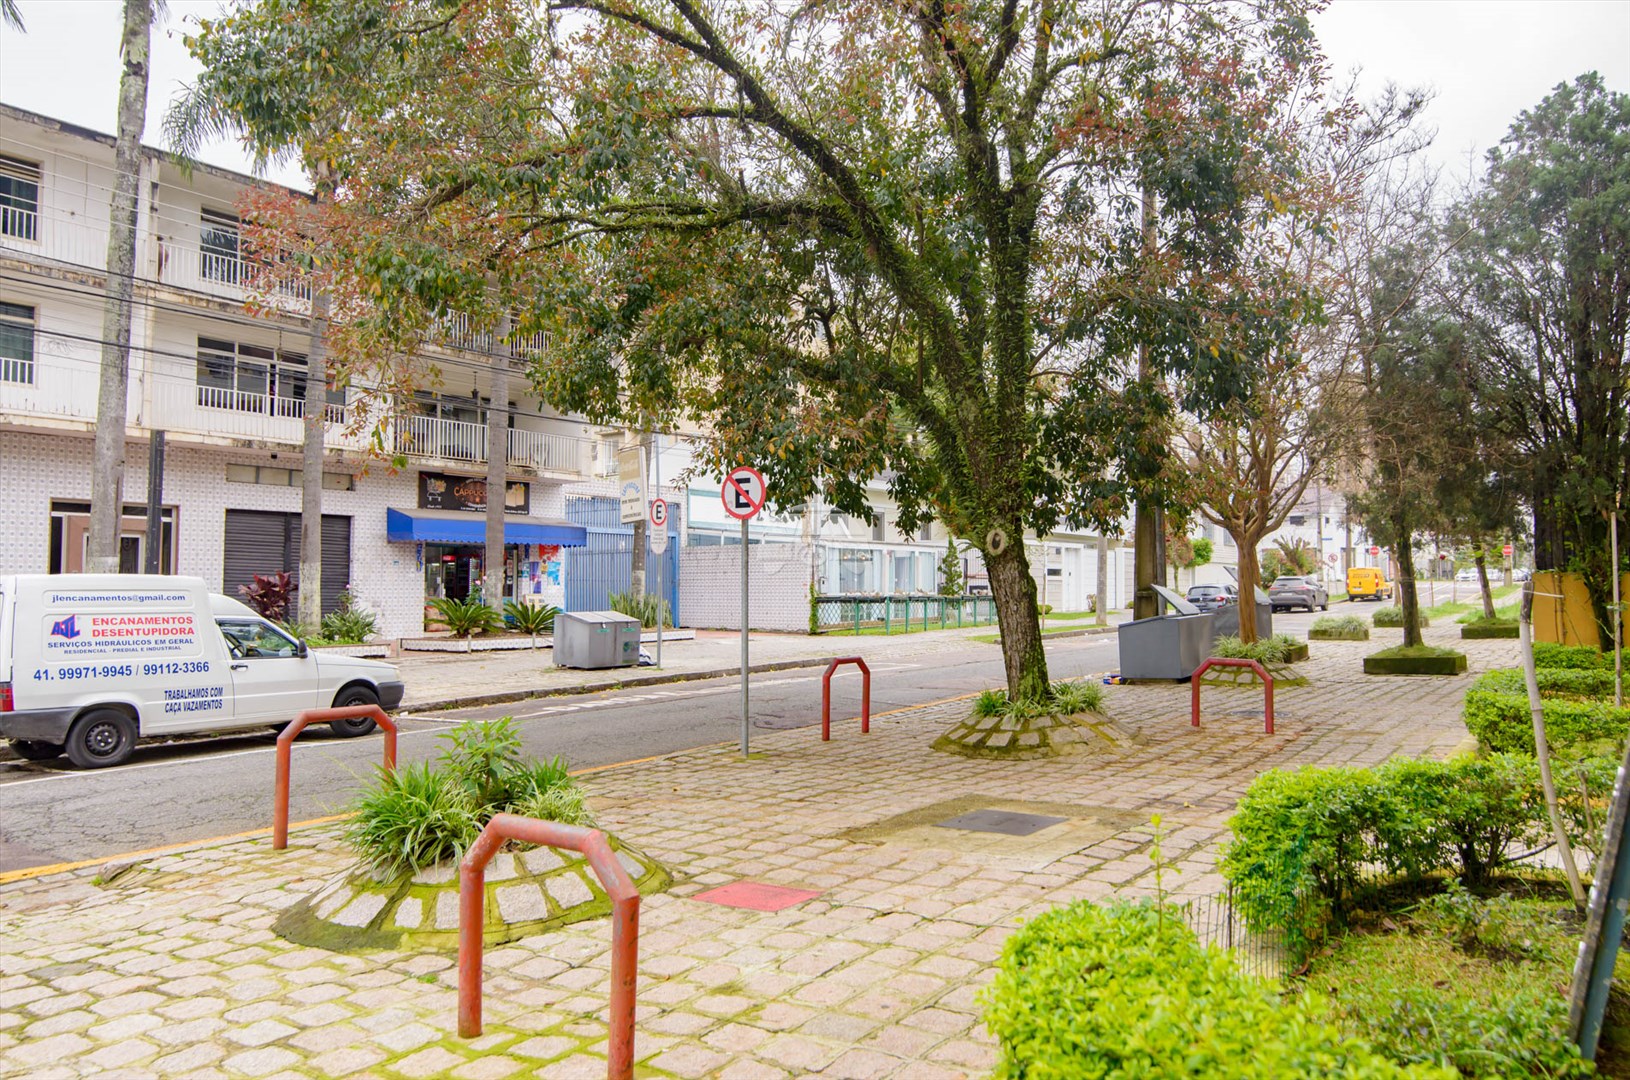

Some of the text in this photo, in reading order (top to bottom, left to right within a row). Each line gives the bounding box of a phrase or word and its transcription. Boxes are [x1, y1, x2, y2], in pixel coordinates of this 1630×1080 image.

[735, 478, 750, 508] E
[656, 505, 662, 519] E
[52, 594, 186, 603] jlencanamentos@gmail.com
[92, 616, 193, 626] ENCANAMENTOS
[92, 627, 195, 638] DESENTUPIDORA
[34, 669, 54, 681] 41.
[59, 665, 132, 680] 99971-9945
[143, 661, 209, 675] 99112-3366
[164, 687, 223, 701] TRABALHAMOS COM
[165, 699, 223, 715] CAÇA VAZAMENTOS
